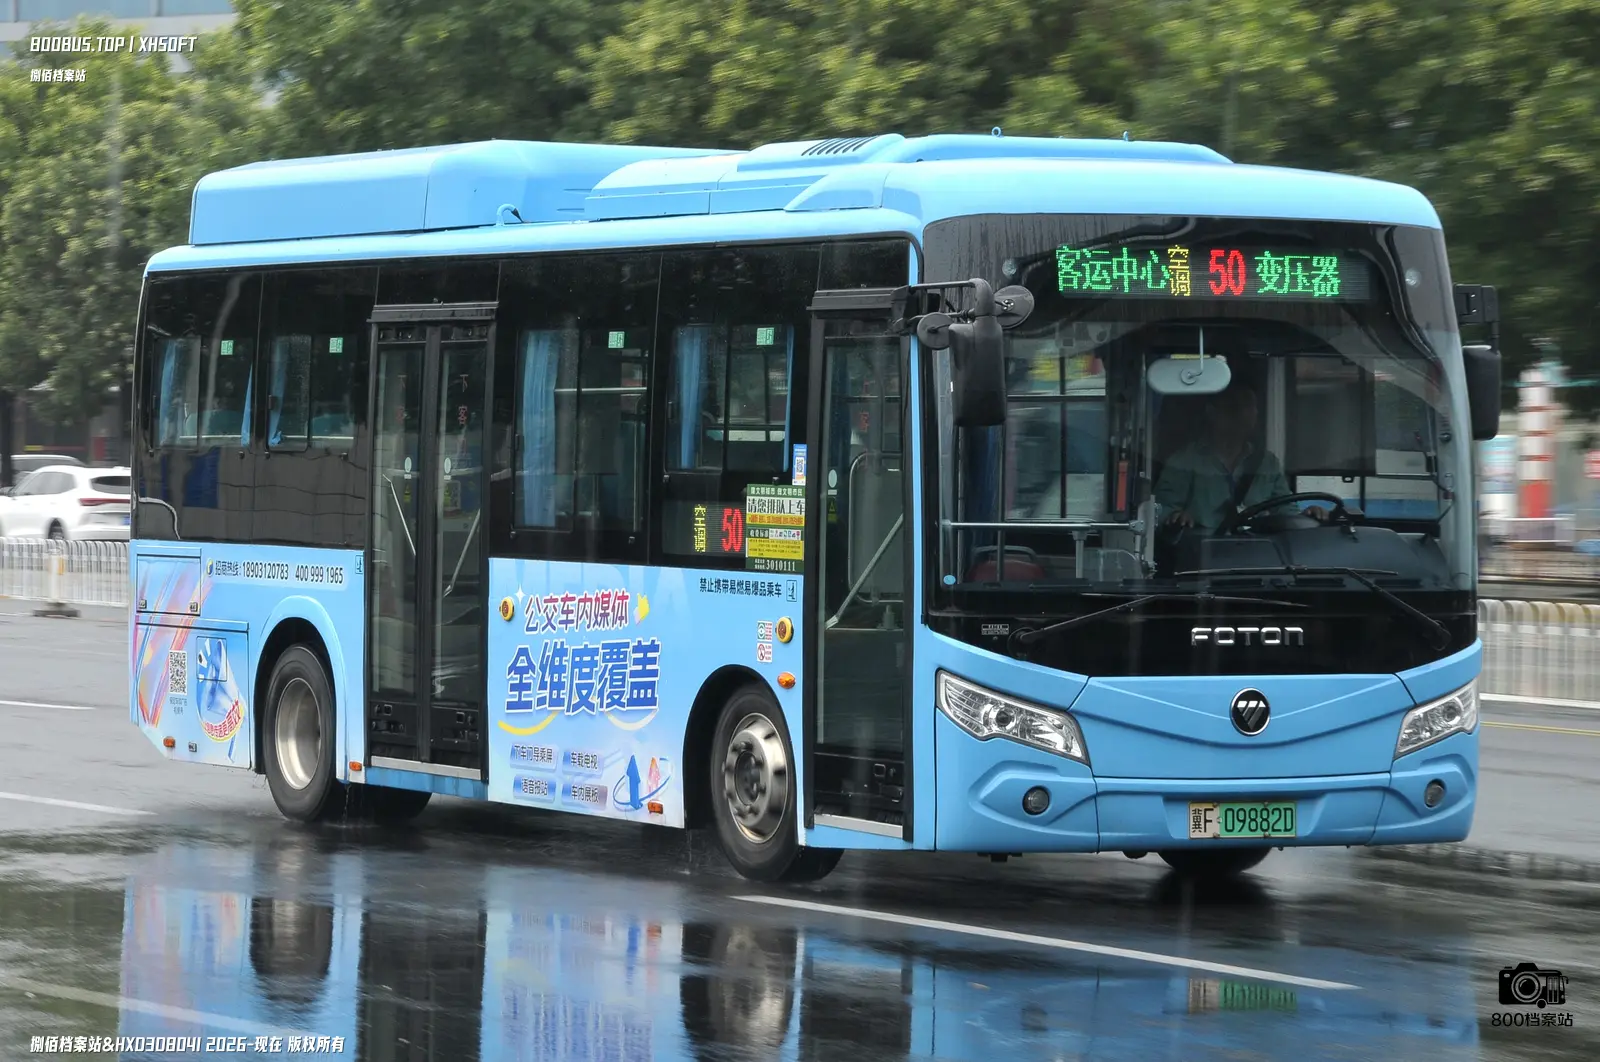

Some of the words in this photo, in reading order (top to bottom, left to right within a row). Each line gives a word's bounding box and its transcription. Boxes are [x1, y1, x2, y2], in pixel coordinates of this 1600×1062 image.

[1055, 245, 1170, 293] 客运中心
[1208, 249, 1246, 296] 50
[1254, 250, 1341, 297] 变压器
[747, 498, 805, 515] 请您排队上车
[694, 504, 706, 553] 空调
[721, 508, 743, 552] 50
[242, 561, 289, 580] 18903120783
[295, 565, 309, 582] 400
[310, 566, 324, 583] 999
[326, 567, 343, 584] 1965
[766, 559, 796, 572] 3010111
[699, 577, 782, 598] 禁止携带易燃易爆品乘车
[525, 588, 630, 634] 公交车内媒体
[1191, 627, 1304, 646] FOTON
[505, 637, 661, 715] 全维度覆盖
[571, 751, 598, 769] 车载电视
[571, 785, 599, 803] 车内展板
